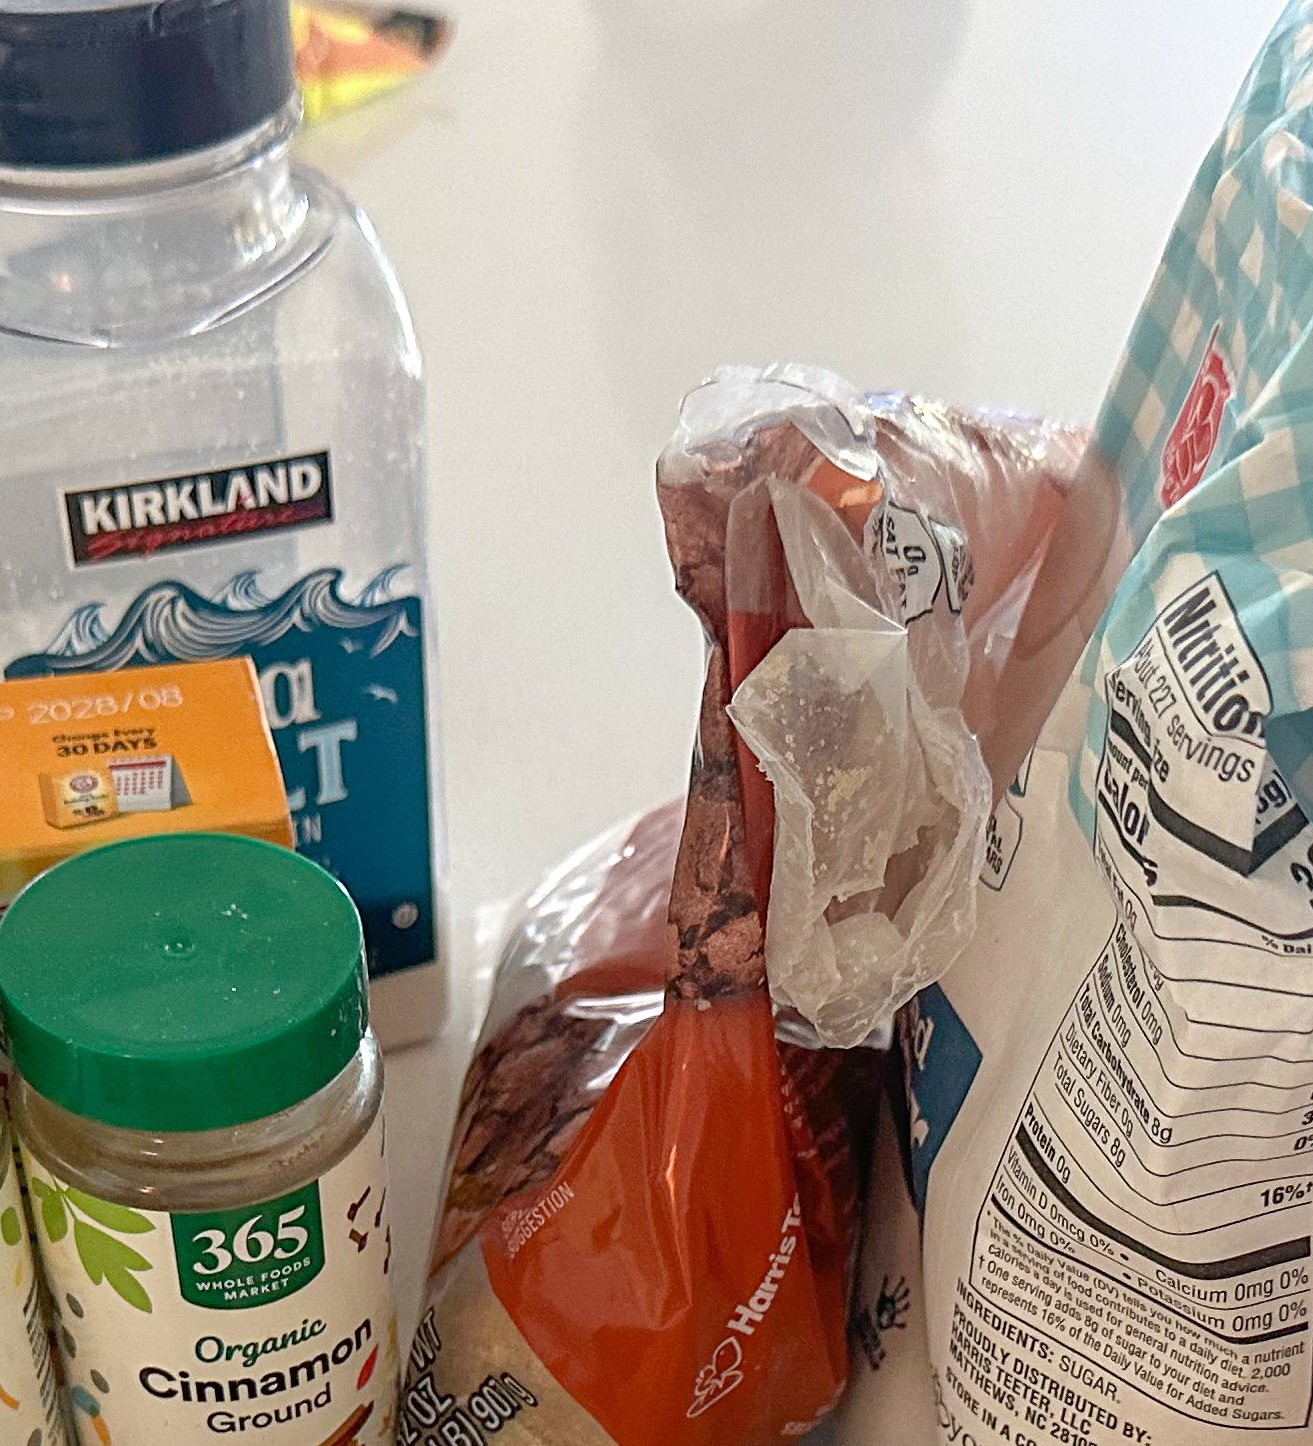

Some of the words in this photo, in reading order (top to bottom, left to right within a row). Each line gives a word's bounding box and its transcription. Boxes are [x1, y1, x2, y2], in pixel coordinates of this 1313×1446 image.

[79, 461, 324, 537] KIRKLAND
[57, 743, 88, 757] 30
[94, 737, 158, 755] DAYS
[1149, 676, 1176, 720] 227
[1167, 714, 1255, 783] servings
[1111, 1004, 1131, 1048] 0mg
[1141, 1001, 1163, 1046] 0mg
[1065, 1022, 1097, 1079] Dietary
[1096, 1072, 1121, 1114] Fiber
[1079, 982, 1097, 1030] Total
[1091, 1021, 1150, 1124] Carbohydrate
[1151, 1119, 1173, 1143] 8g
[1053, 1051, 1076, 1096] Total
[1073, 1088, 1111, 1145] Sugars
[1024, 1102, 1056, 1164] Protein
[191, 1204, 310, 1275] 365
[995, 1174, 1015, 1207] Iron
[1017, 1203, 1046, 1238] 0mg
[195, 1275, 255, 1293] WHOLE
[260, 1257, 312, 1283] FOODS
[223, 1278, 290, 1301] MARKET
[727, 1238, 799, 1335] Harris
[1138, 1277, 1225, 1331] Potassium
[1232, 1309, 1273, 1332] 0mg
[1278, 1300, 1307, 1322] 0%
[1155, 1269, 1228, 1304] Calcium
[1234, 1278, 1274, 1302] 0mg
[1280, 1266, 1309, 1290] 0%
[139, 1318, 373, 1403] Cinnamon
[194, 1318, 327, 1368] Organic
[954, 1302, 1010, 1365] PROUDLY
[1013, 1357, 1117, 1430] DISTRIBUTED
[1122, 1422, 1152, 1446] BY:
[956, 1277, 1055, 1363] INGREDIENTS:
[1059, 1355, 1121, 1404] SUGAR.
[981, 1276, 1038, 1316] represents
[1041, 1308, 1067, 1332] 16%
[1102, 1344, 1132, 1371] Daily
[1133, 1362, 1164, 1390] Value
[1186, 1396, 1228, 1417] Added
[206, 1382, 333, 1434] Ground
[407, 1376, 453, 1427] OZ
[949, 1339, 1019, 1416] MATTHEWS,
[1025, 1406, 1047, 1430] NC
[952, 1321, 992, 1375] HARRIS
[996, 1365, 1054, 1418] TEETER,
[1060, 1408, 1091, 1435] LLC
[982, 1409, 996, 1430] IN
[1000, 1426, 1011, 1441] A
